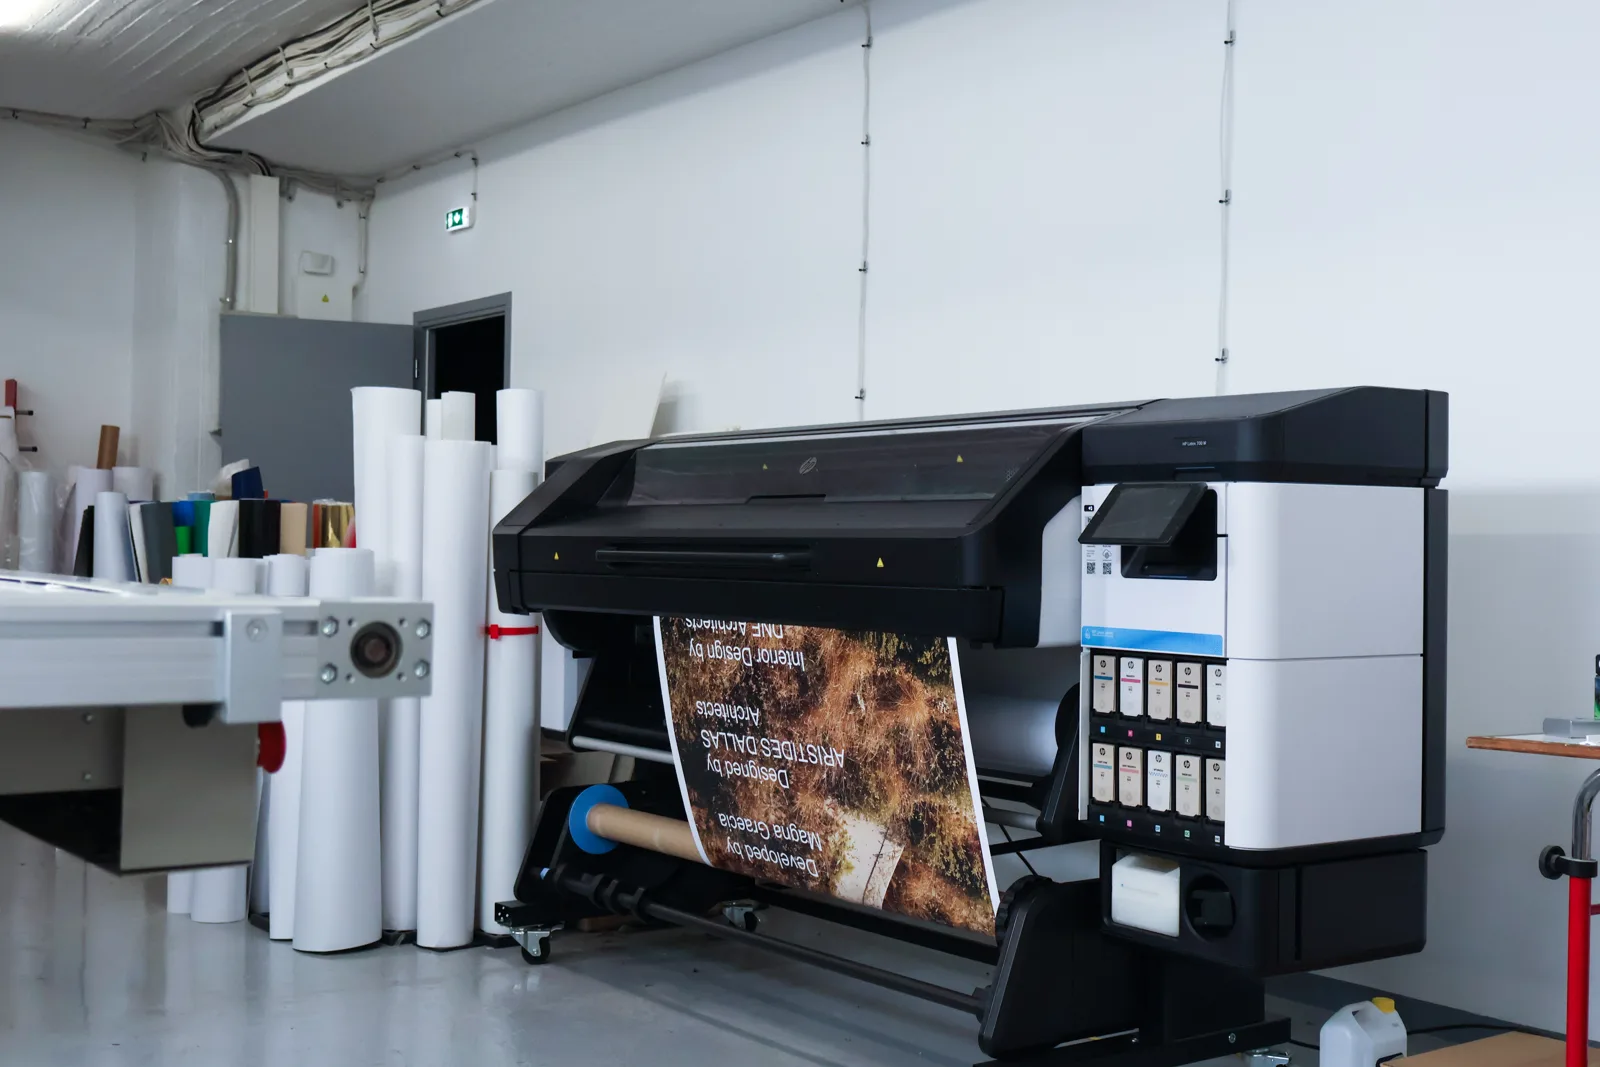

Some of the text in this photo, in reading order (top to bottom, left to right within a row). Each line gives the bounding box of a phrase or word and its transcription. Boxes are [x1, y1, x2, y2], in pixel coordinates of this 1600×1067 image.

[688, 638, 804, 671] Interior Design by
[696, 699, 759, 727] Architects
[701, 730, 844, 768] ARISTIDES DALLAS
[707, 754, 789, 788] Designed by
[718, 813, 822, 852] Magna Graecia
[727, 837, 818, 878] Developed by
